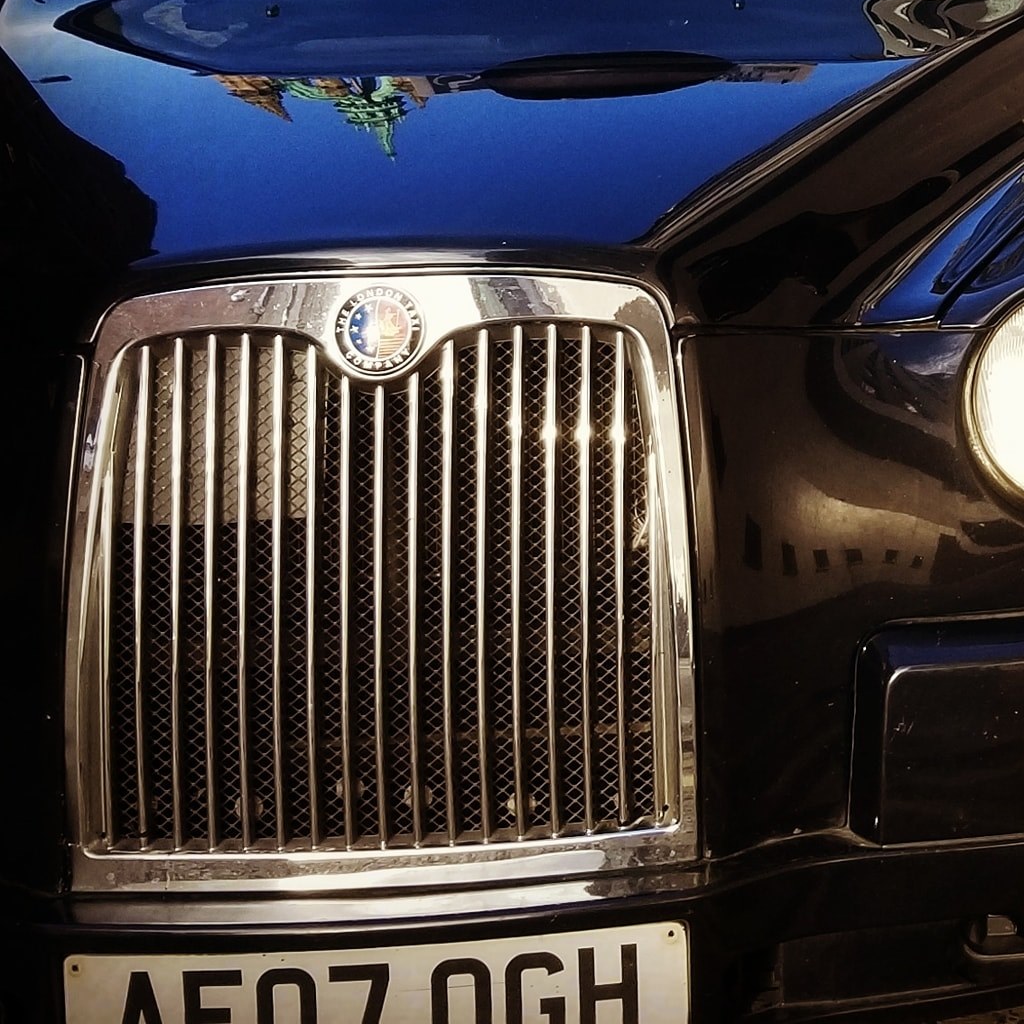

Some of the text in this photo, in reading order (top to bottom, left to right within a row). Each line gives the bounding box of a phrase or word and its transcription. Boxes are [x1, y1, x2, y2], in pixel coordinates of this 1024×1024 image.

[336, 288, 420, 333] THE LONDON TAXI
[121, 943, 639, 1024] AE07 OGH
